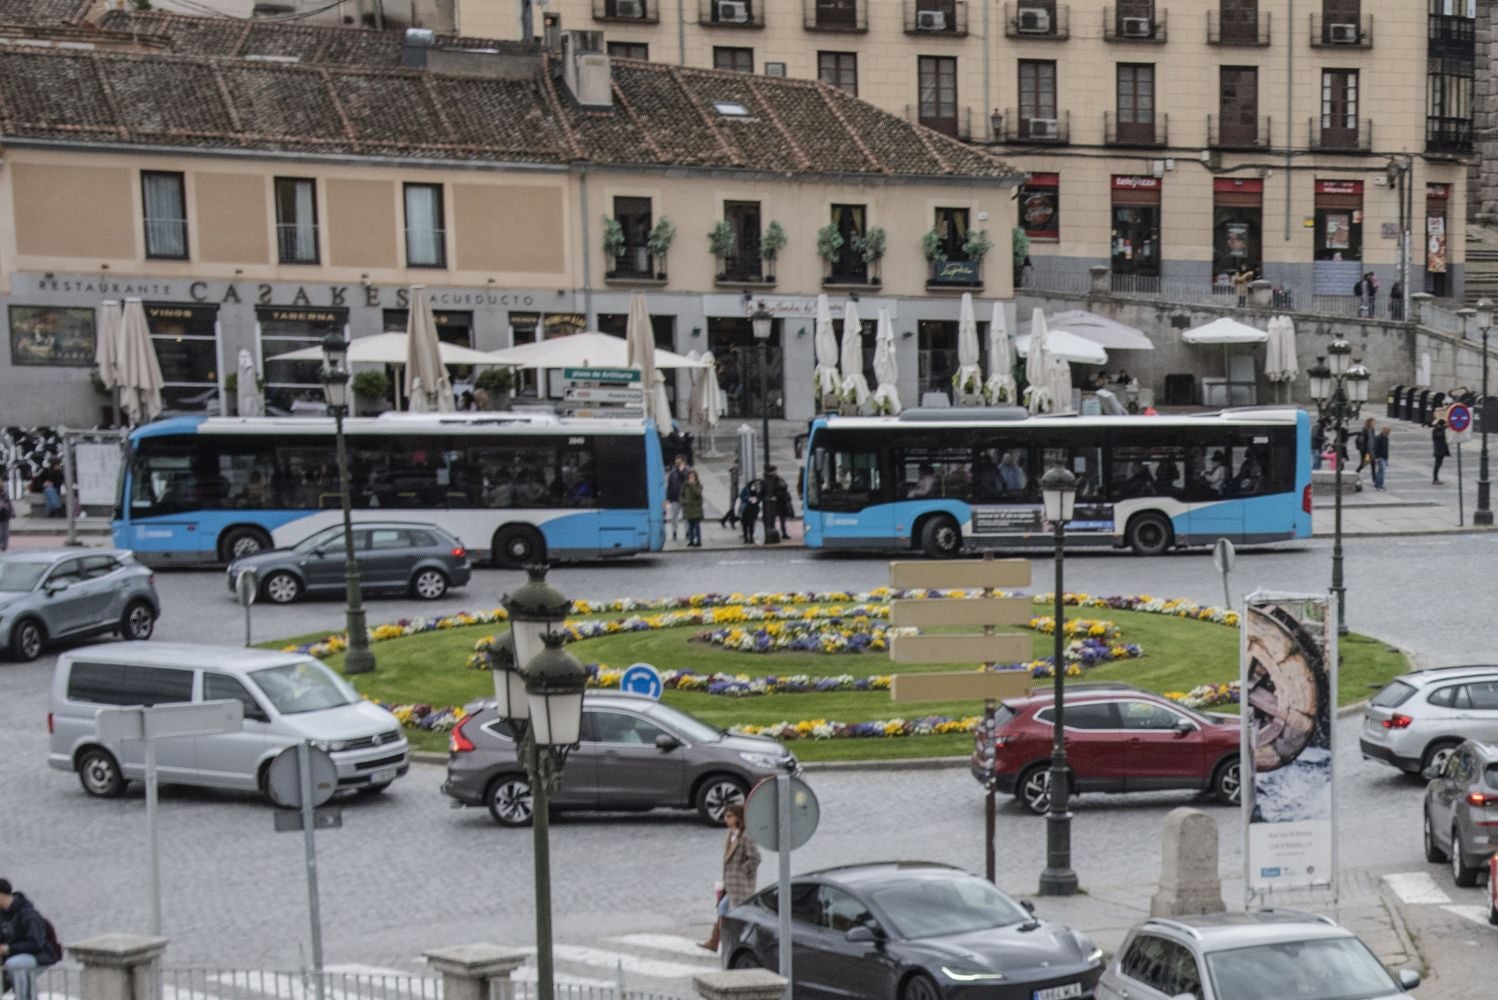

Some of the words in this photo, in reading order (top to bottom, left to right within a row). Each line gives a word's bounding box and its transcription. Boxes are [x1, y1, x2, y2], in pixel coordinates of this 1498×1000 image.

[39, 280, 171, 296] RESTAURANTE
[430, 294, 534, 306] ACUEDUCTO
[272, 311, 336, 321] TABERNA
